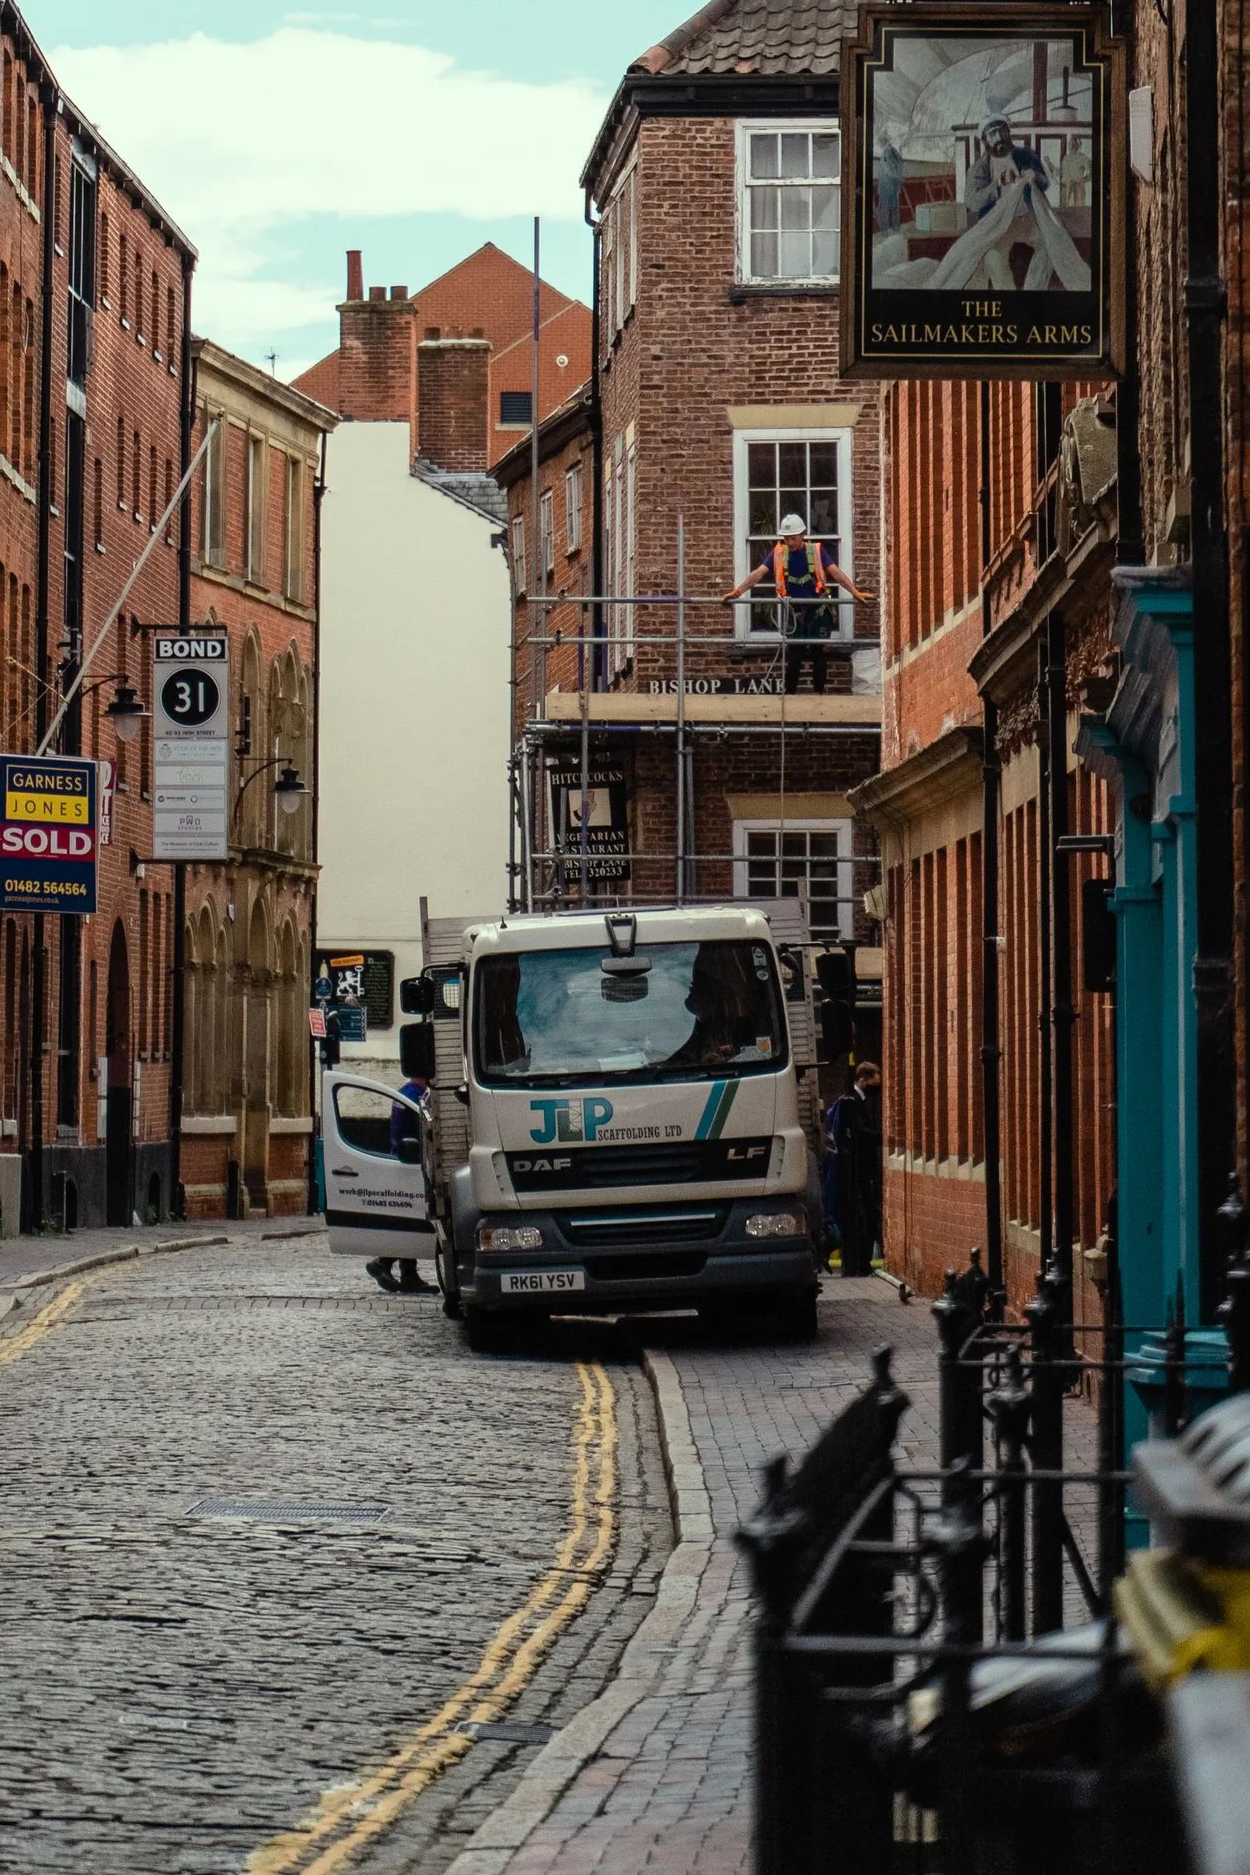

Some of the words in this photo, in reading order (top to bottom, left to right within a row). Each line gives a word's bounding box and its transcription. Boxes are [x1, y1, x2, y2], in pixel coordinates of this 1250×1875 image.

[961, 301, 1001, 316] THE
[871, 324, 1017, 343] SAILMAKERS
[1026, 325, 1091, 343] ARMS
[159, 640, 222, 657] BOND
[650, 679, 721, 694] BISHOP
[735, 678, 786, 694] LANE
[174, 681, 205, 713] 31
[13, 773, 83, 792] GARNESS
[13, 799, 82, 817] JONES
[2, 827, 92, 855] SOLD
[589, 867, 623, 878] 320233
[5, 879, 41, 894] 01482
[43, 881, 87, 896] 564564
[530, 1097, 614, 1144] JLP
[598, 1126, 660, 1141] SCAFFOLDING
[665, 1125, 682, 1137] LTD
[727, 1147, 766, 1161] LF
[513, 1158, 571, 1172] DAF
[510, 1275, 543, 1290] RK61
[547, 1274, 575, 1289] YSV
